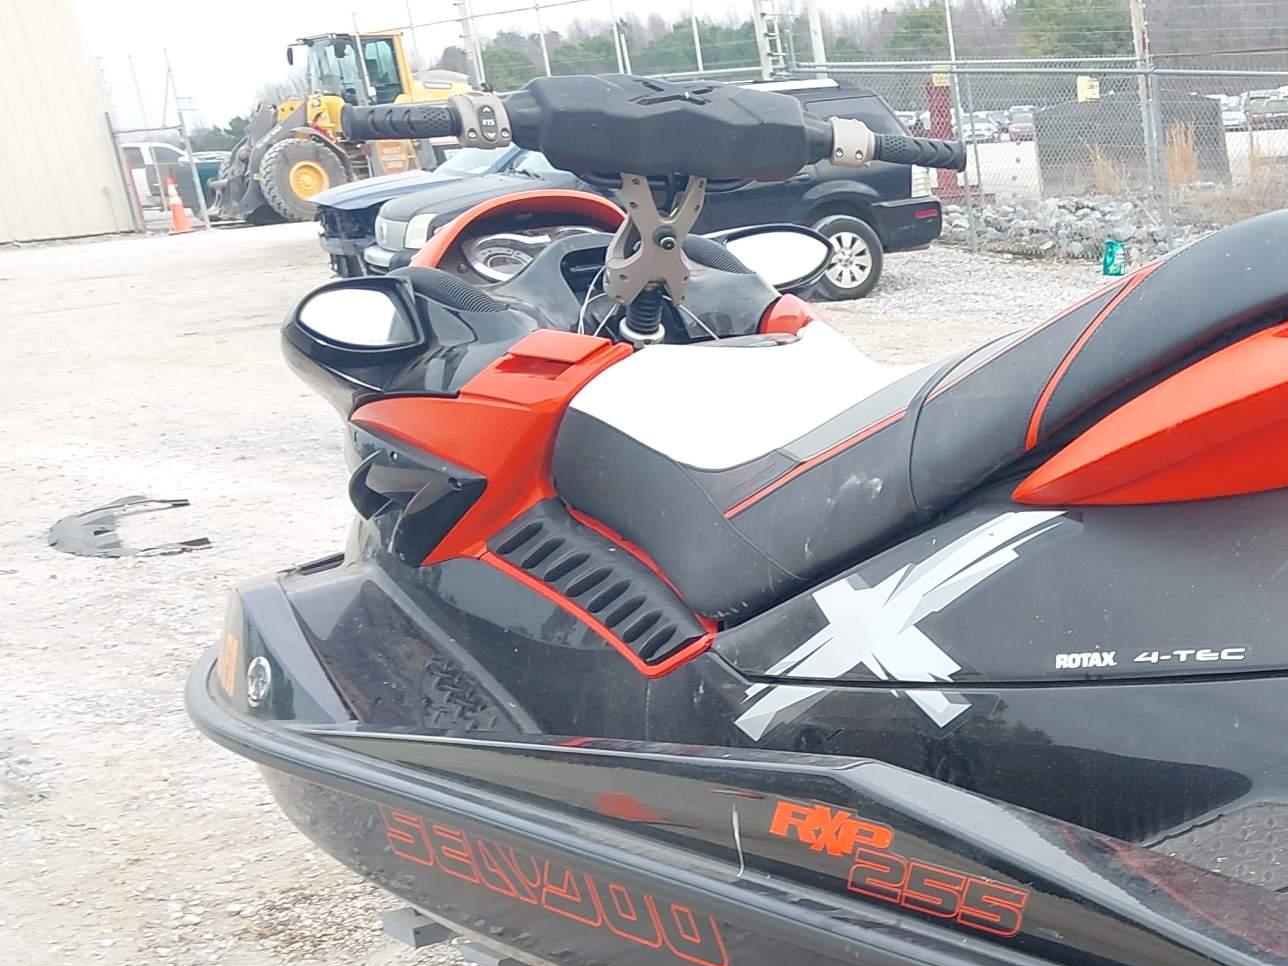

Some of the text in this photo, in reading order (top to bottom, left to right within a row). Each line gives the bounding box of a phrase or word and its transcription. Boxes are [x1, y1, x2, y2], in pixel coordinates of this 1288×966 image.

[1055, 648, 1246, 669] ROTAX 4-TEC
[769, 800, 894, 857] RXP
[848, 848, 1030, 937] 255
